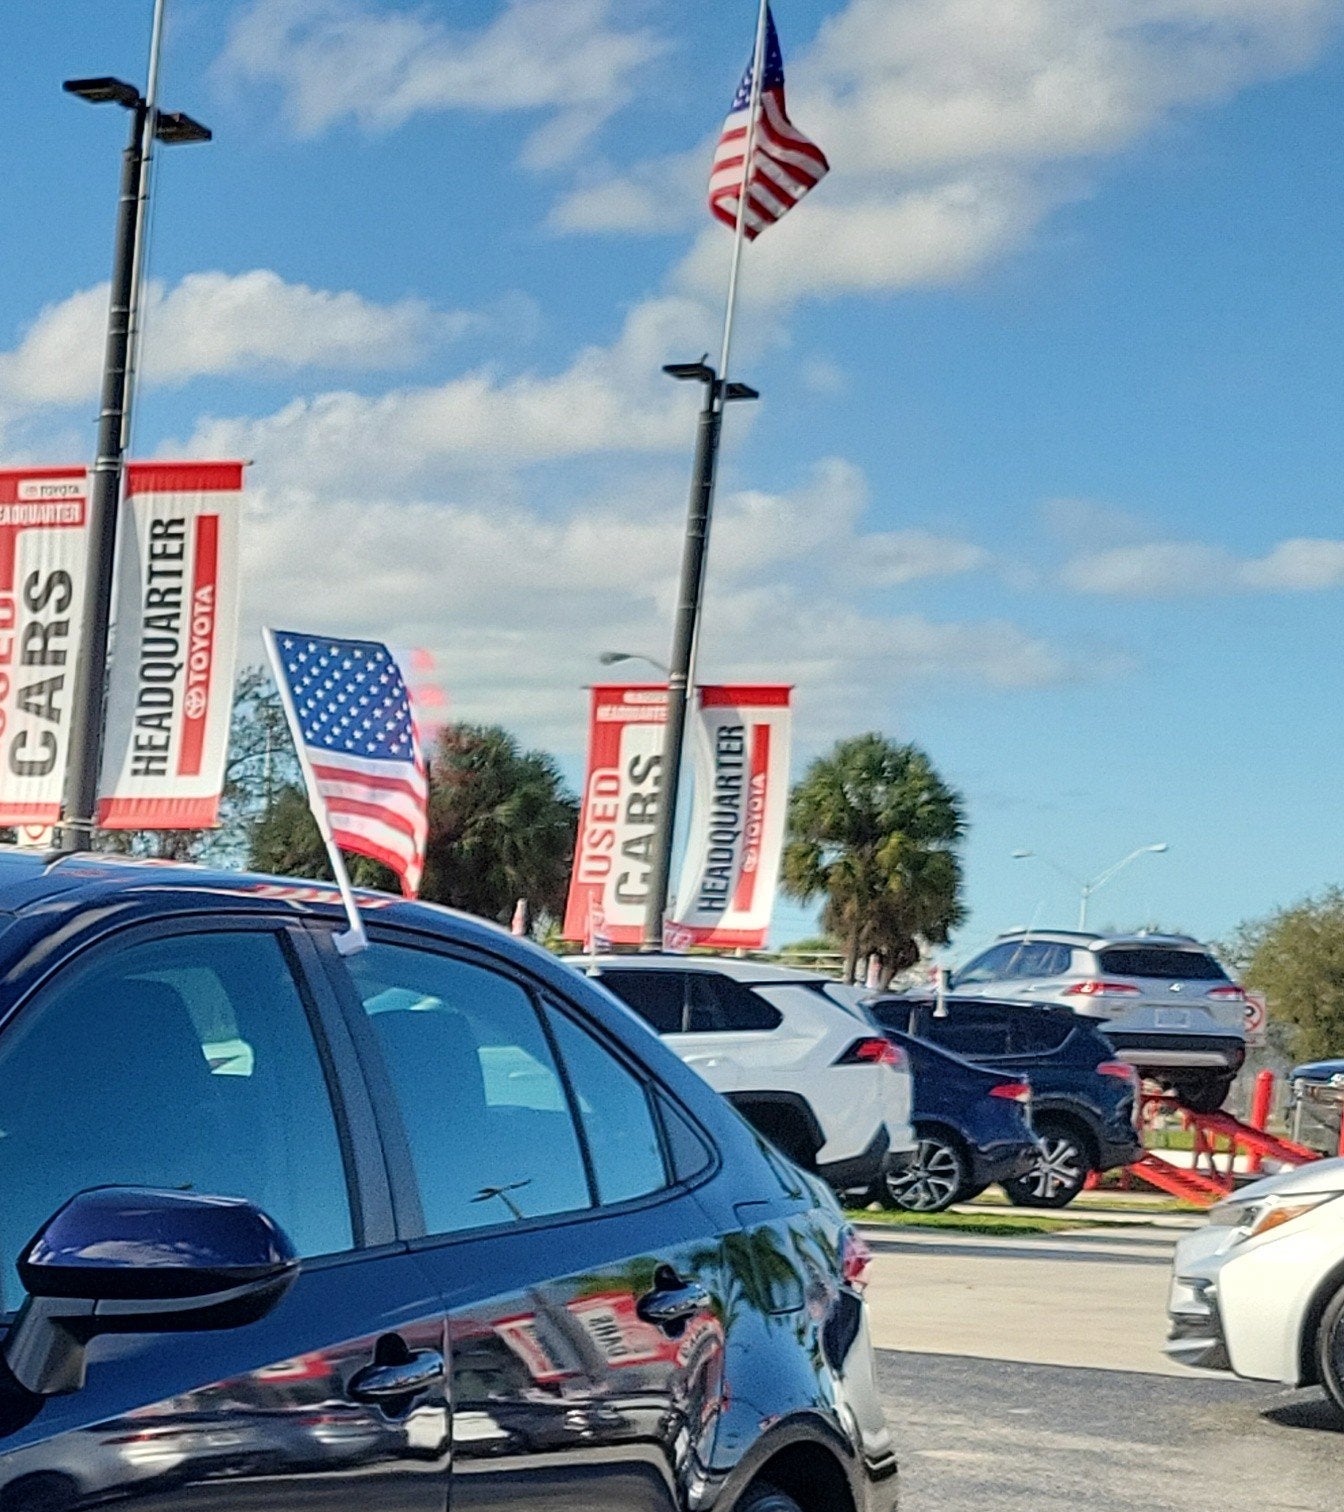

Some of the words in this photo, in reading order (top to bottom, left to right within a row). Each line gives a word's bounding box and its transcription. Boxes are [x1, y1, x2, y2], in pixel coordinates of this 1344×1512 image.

[9, 569, 73, 778] CARS
[130, 517, 186, 778] HEADQUARTER
[188, 583, 215, 686] TOYOTA
[584, 773, 620, 880] USED
[615, 753, 662, 906] CARS
[698, 724, 745, 914] HEADQUARTER
